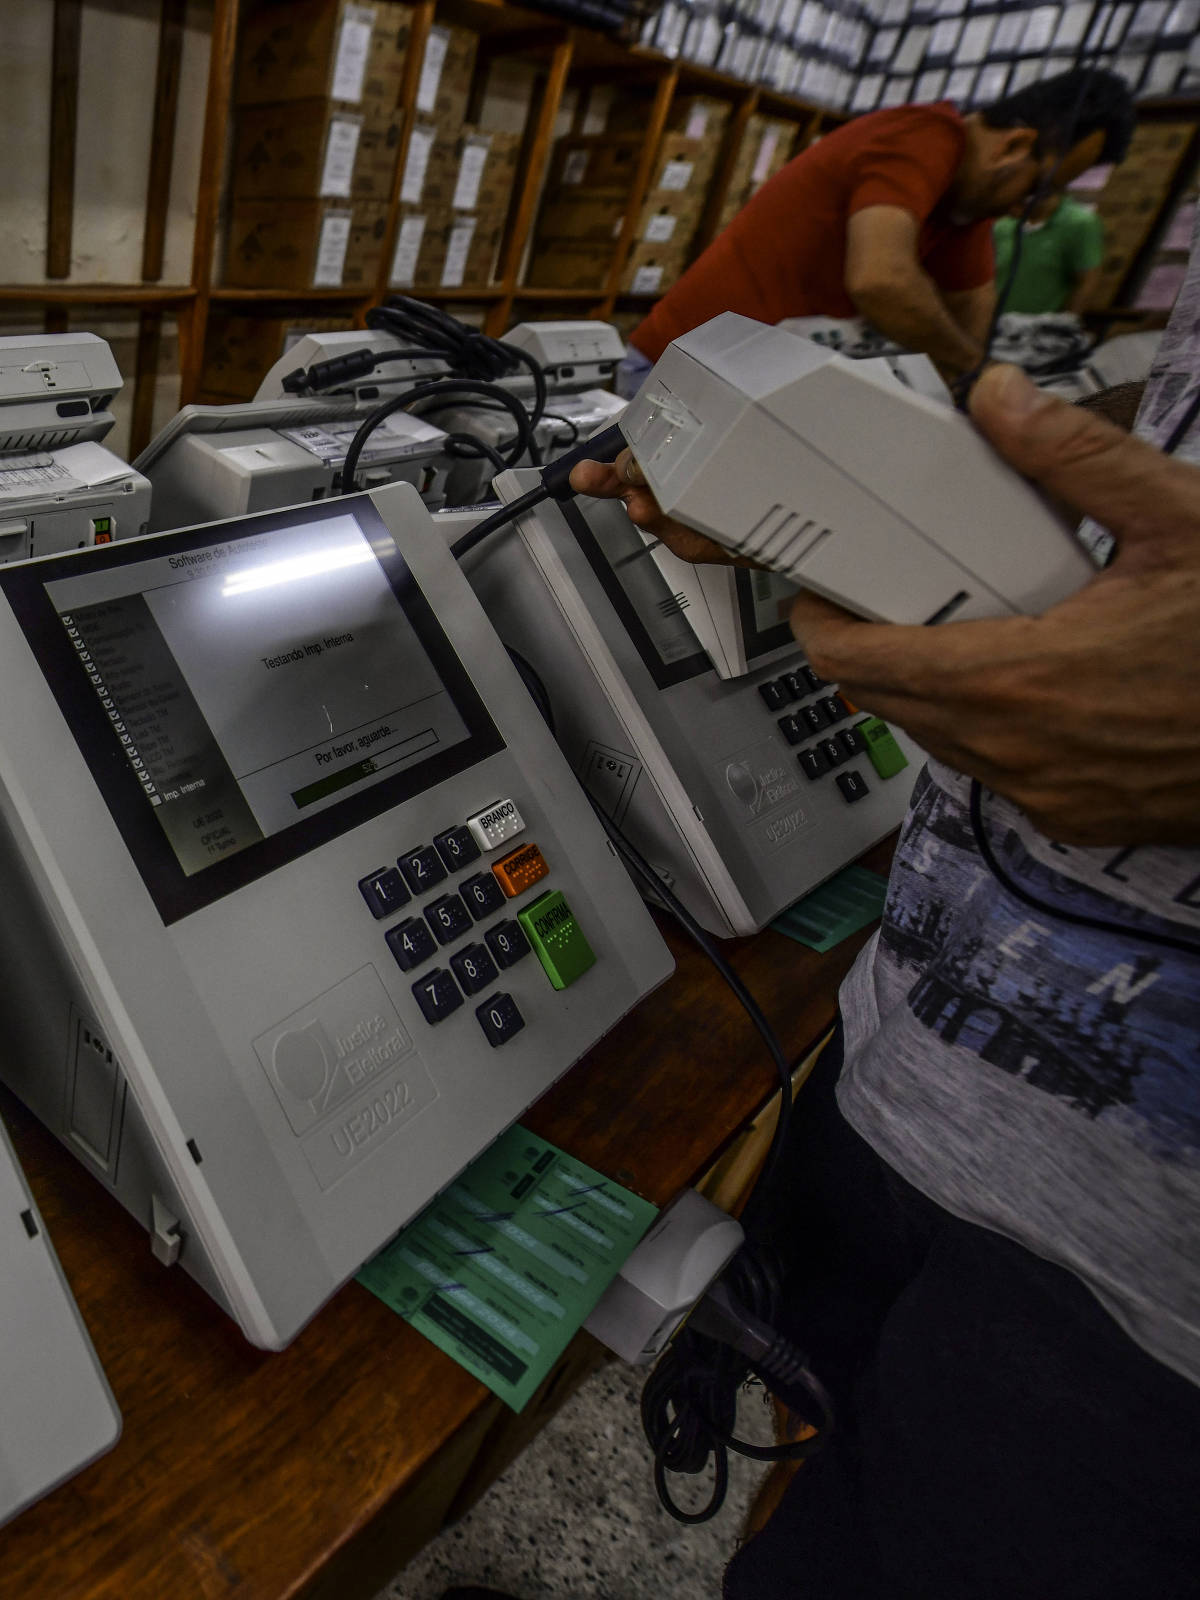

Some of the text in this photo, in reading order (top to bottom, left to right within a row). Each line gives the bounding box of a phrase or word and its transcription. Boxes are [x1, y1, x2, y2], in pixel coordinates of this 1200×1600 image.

[168, 551, 212, 569] Software
[262, 647, 304, 670] Testando
[303, 640, 325, 657] Imp.
[315, 751, 333, 766] Por
[480, 802, 515, 831] BRANCO
[448, 838, 460, 855] 3
[412, 859, 427, 877] 2
[503, 845, 541, 876] CORRIGE
[376, 883, 387, 900] 1
[473, 885, 485, 904] 6
[439, 907, 452, 928] 5
[533, 902, 572, 938] CONFIRMA
[403, 934, 415, 953] 4
[499, 934, 511, 953] 9
[464, 958, 478, 979] 8
[426, 983, 439, 1006] 7
[490, 1009, 504, 1030] 0
[335, 1012, 386, 1059] Justiça
[344, 1030, 407, 1088] Eleitoral
[329, 1082, 414, 1158] UE2022
